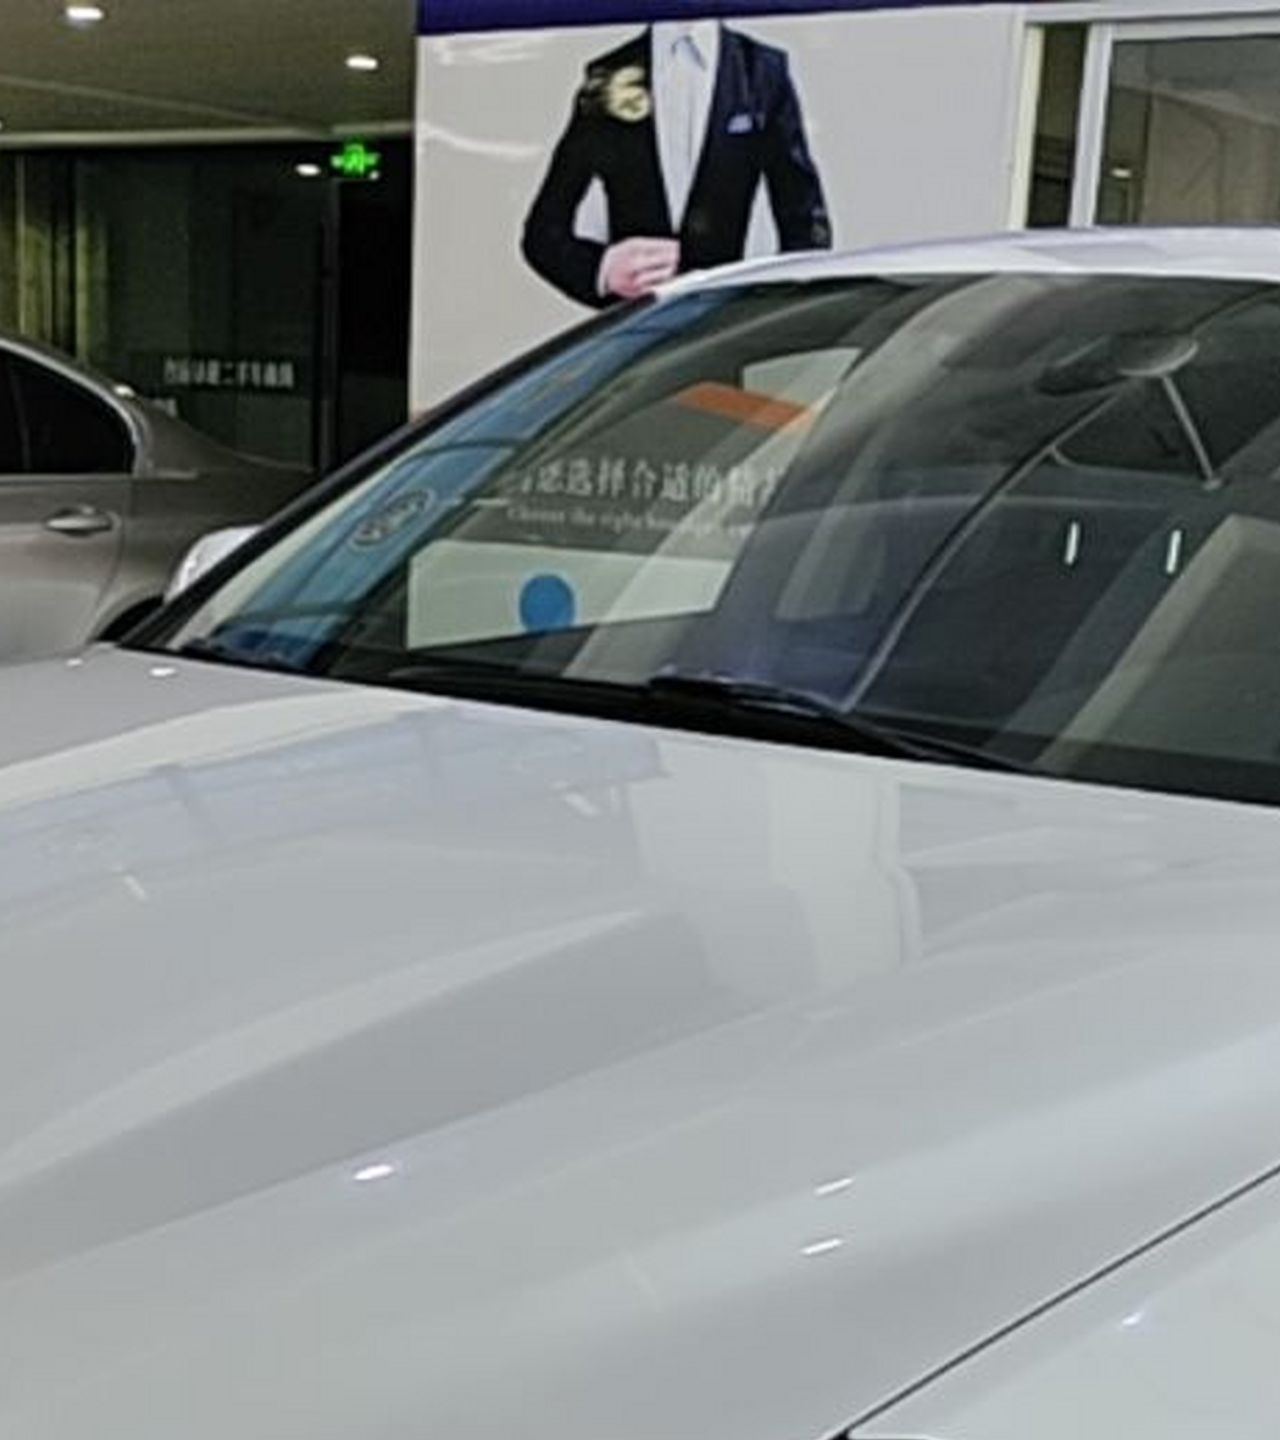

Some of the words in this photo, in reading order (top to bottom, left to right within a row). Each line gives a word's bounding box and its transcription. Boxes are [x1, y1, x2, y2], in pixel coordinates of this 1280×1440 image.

[520, 456, 780, 508] 您选择合适的
